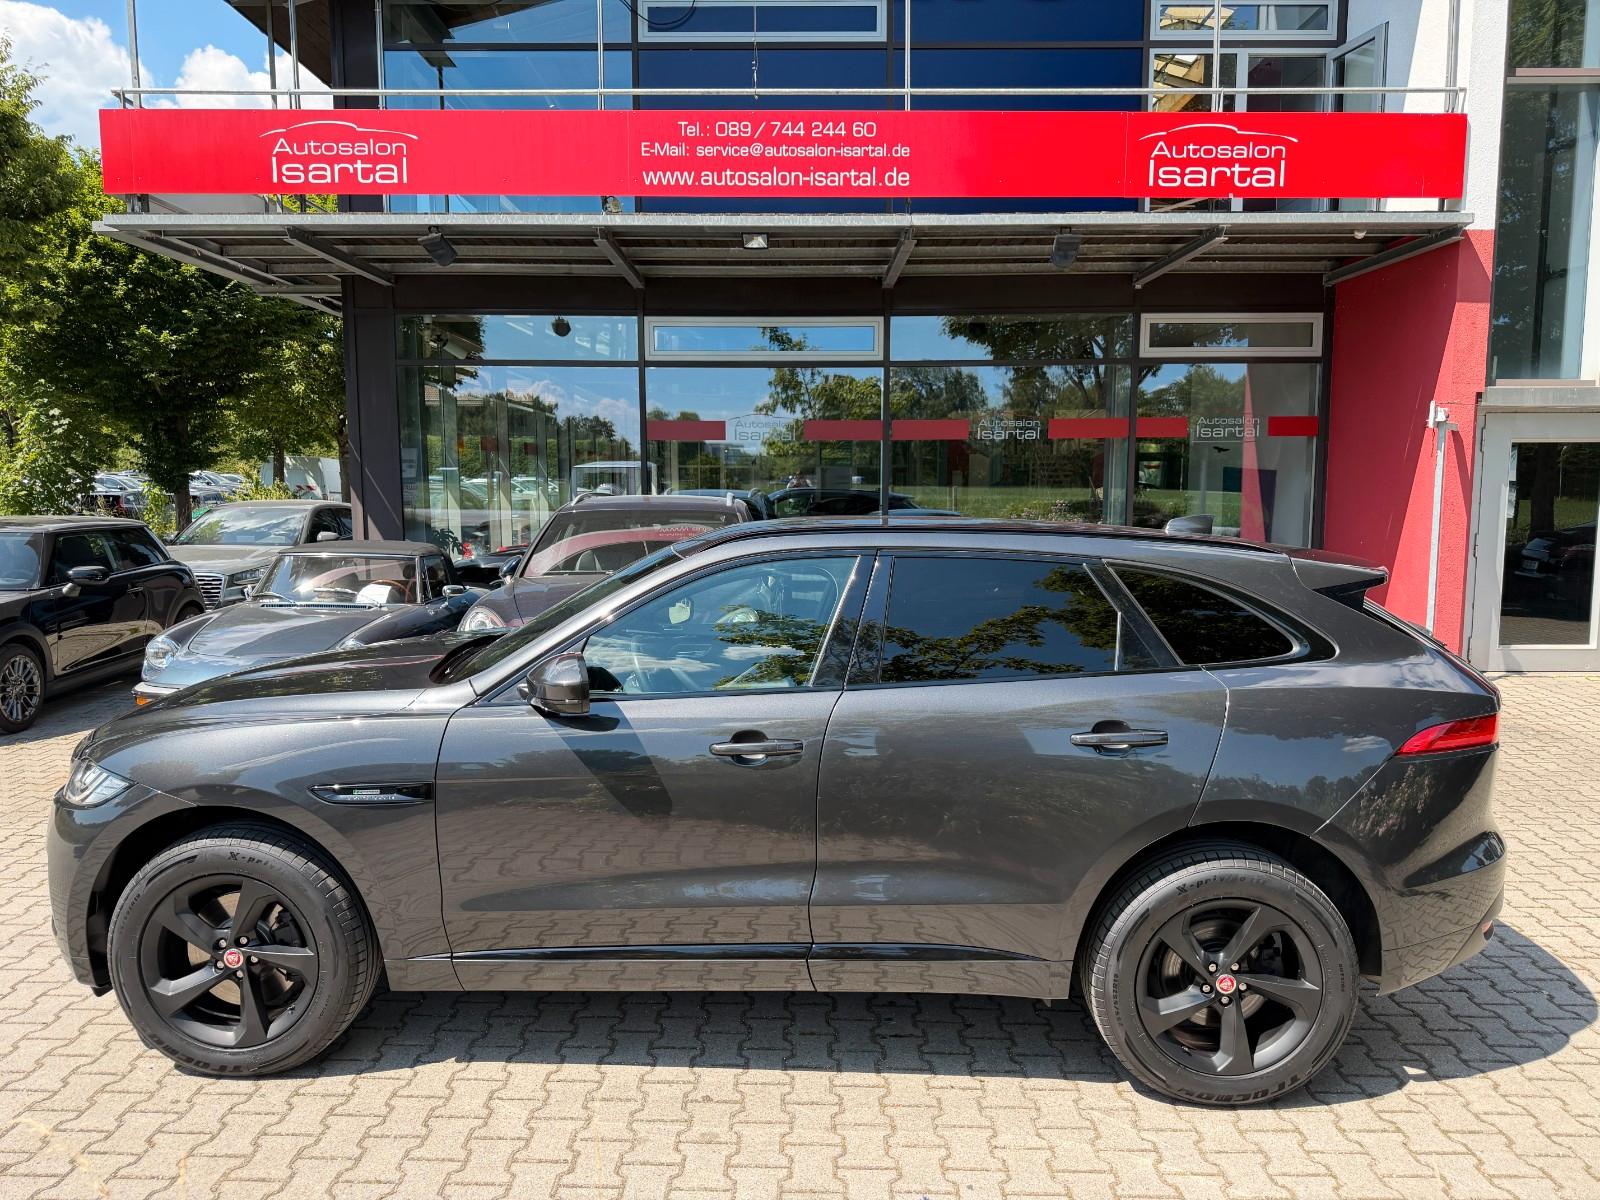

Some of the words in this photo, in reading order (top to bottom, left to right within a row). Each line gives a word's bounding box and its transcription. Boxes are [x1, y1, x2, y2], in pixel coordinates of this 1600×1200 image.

[811, 121, 847, 137] 244
[852, 121, 878, 138] 60
[272, 137, 408, 156] Autosalon
[640, 141, 691, 157] E-Mail:
[696, 142, 911, 158] service@autosalon-isartal.de
[1150, 140, 1287, 159] Autosalon
[271, 156, 408, 184] Isartal
[642, 166, 911, 187] www.autosalon-isartal.de
[1149, 159, 1286, 188] Isartal
[979, 418, 1041, 428] Autosalon
[1197, 415, 1260, 425] Autosalon
[977, 427, 1041, 440] Isartal
[1196, 424, 1260, 438] Isartal
